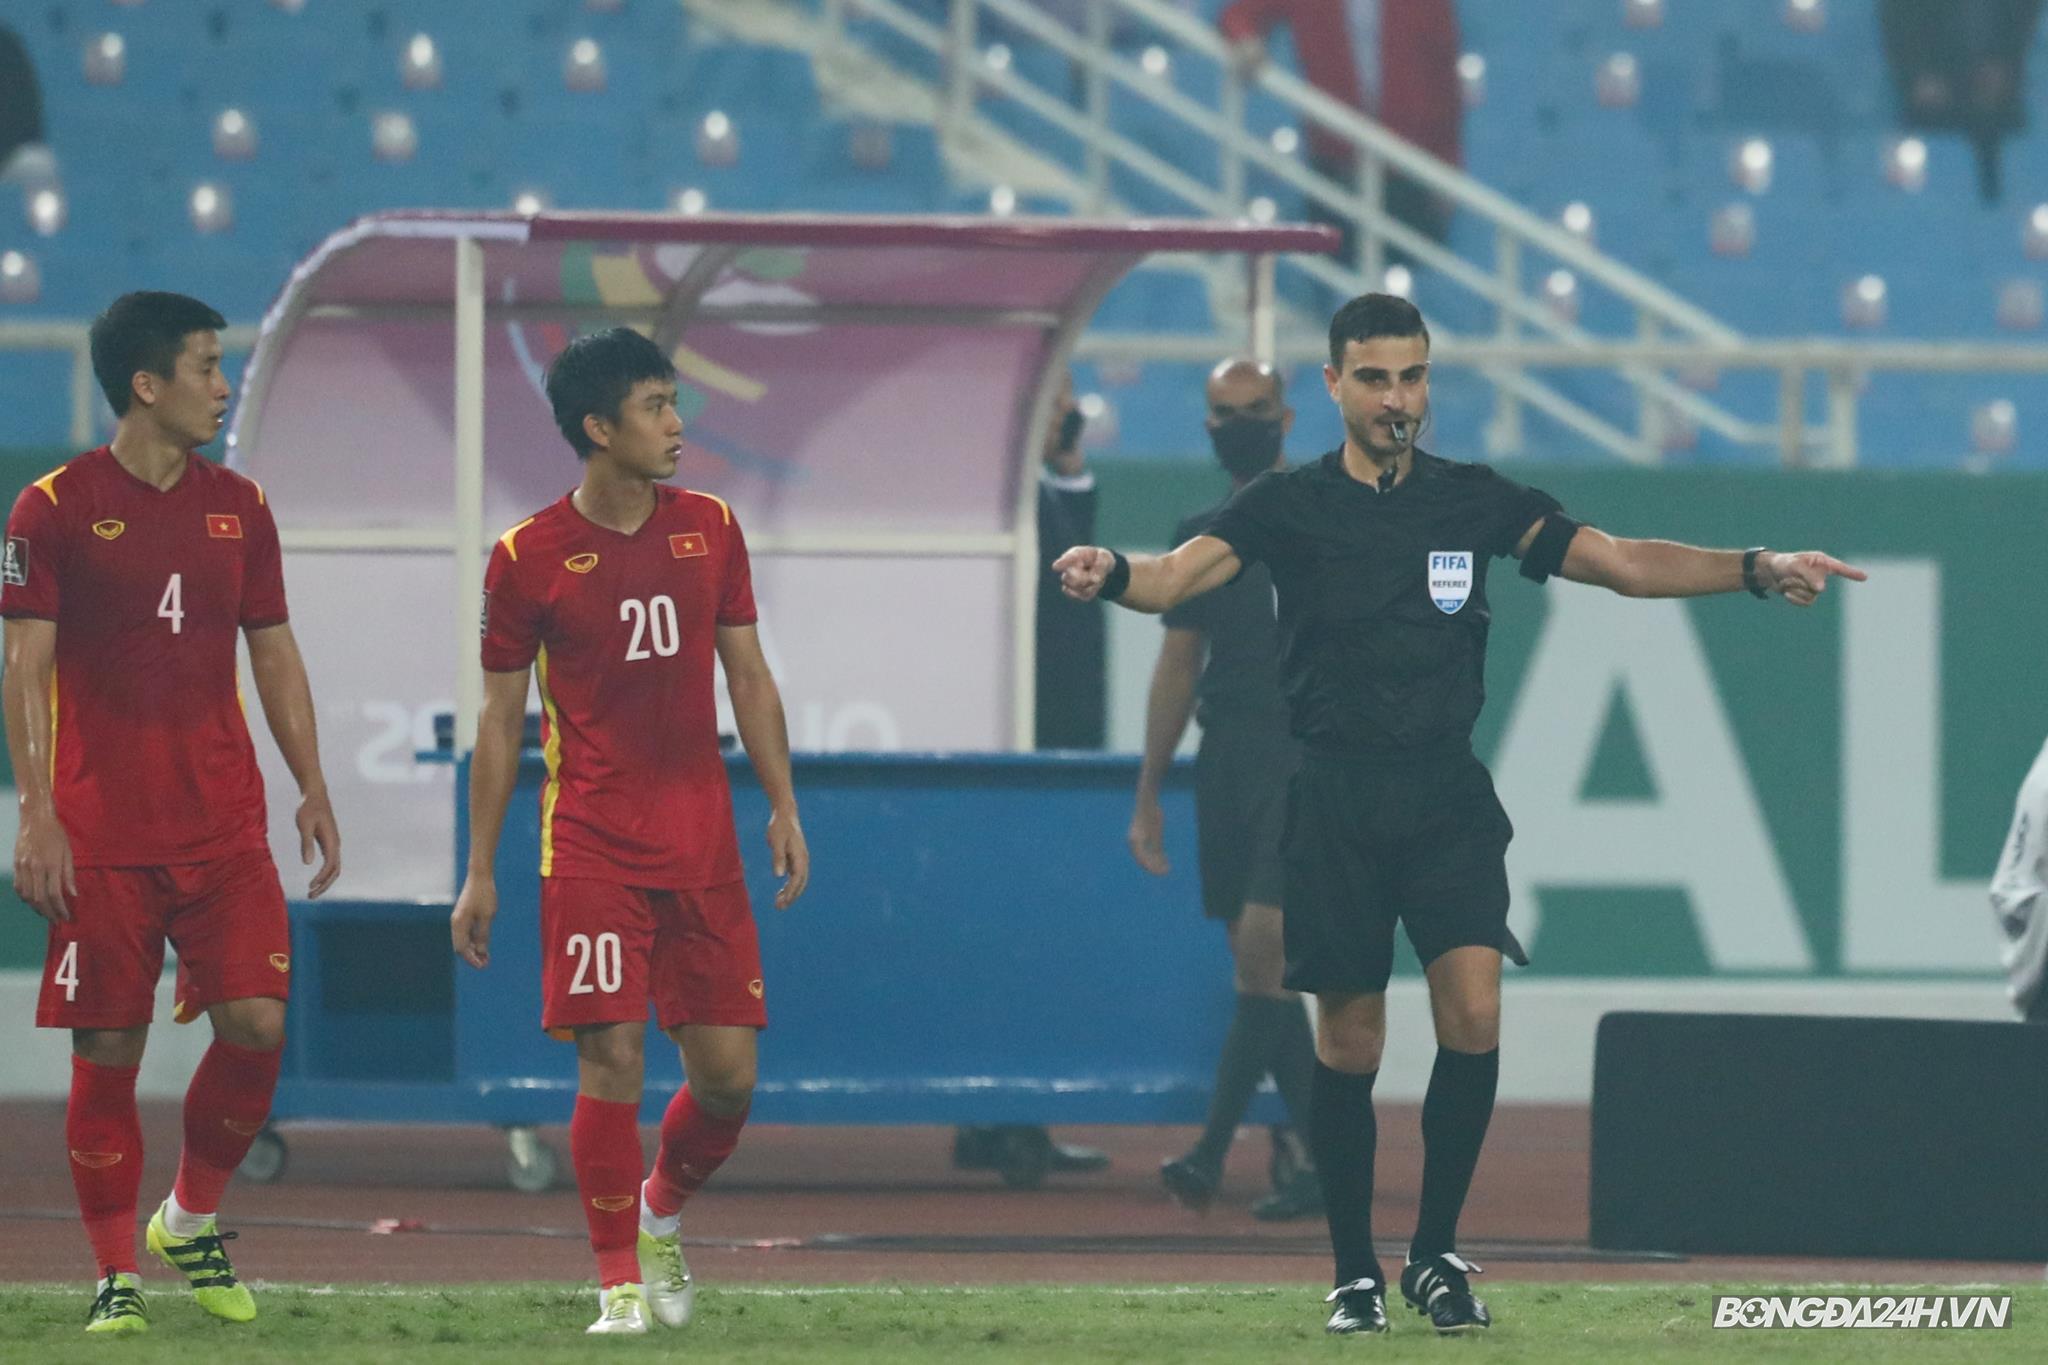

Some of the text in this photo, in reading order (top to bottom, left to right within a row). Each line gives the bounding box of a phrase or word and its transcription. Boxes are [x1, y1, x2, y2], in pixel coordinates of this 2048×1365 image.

[1432, 556, 1467, 570] FIFA
[1432, 580, 1467, 588] REFEREE
[157, 573, 184, 634] 4
[620, 595, 680, 661] 20
[54, 941, 79, 1001] 4
[566, 932, 622, 995] 20
